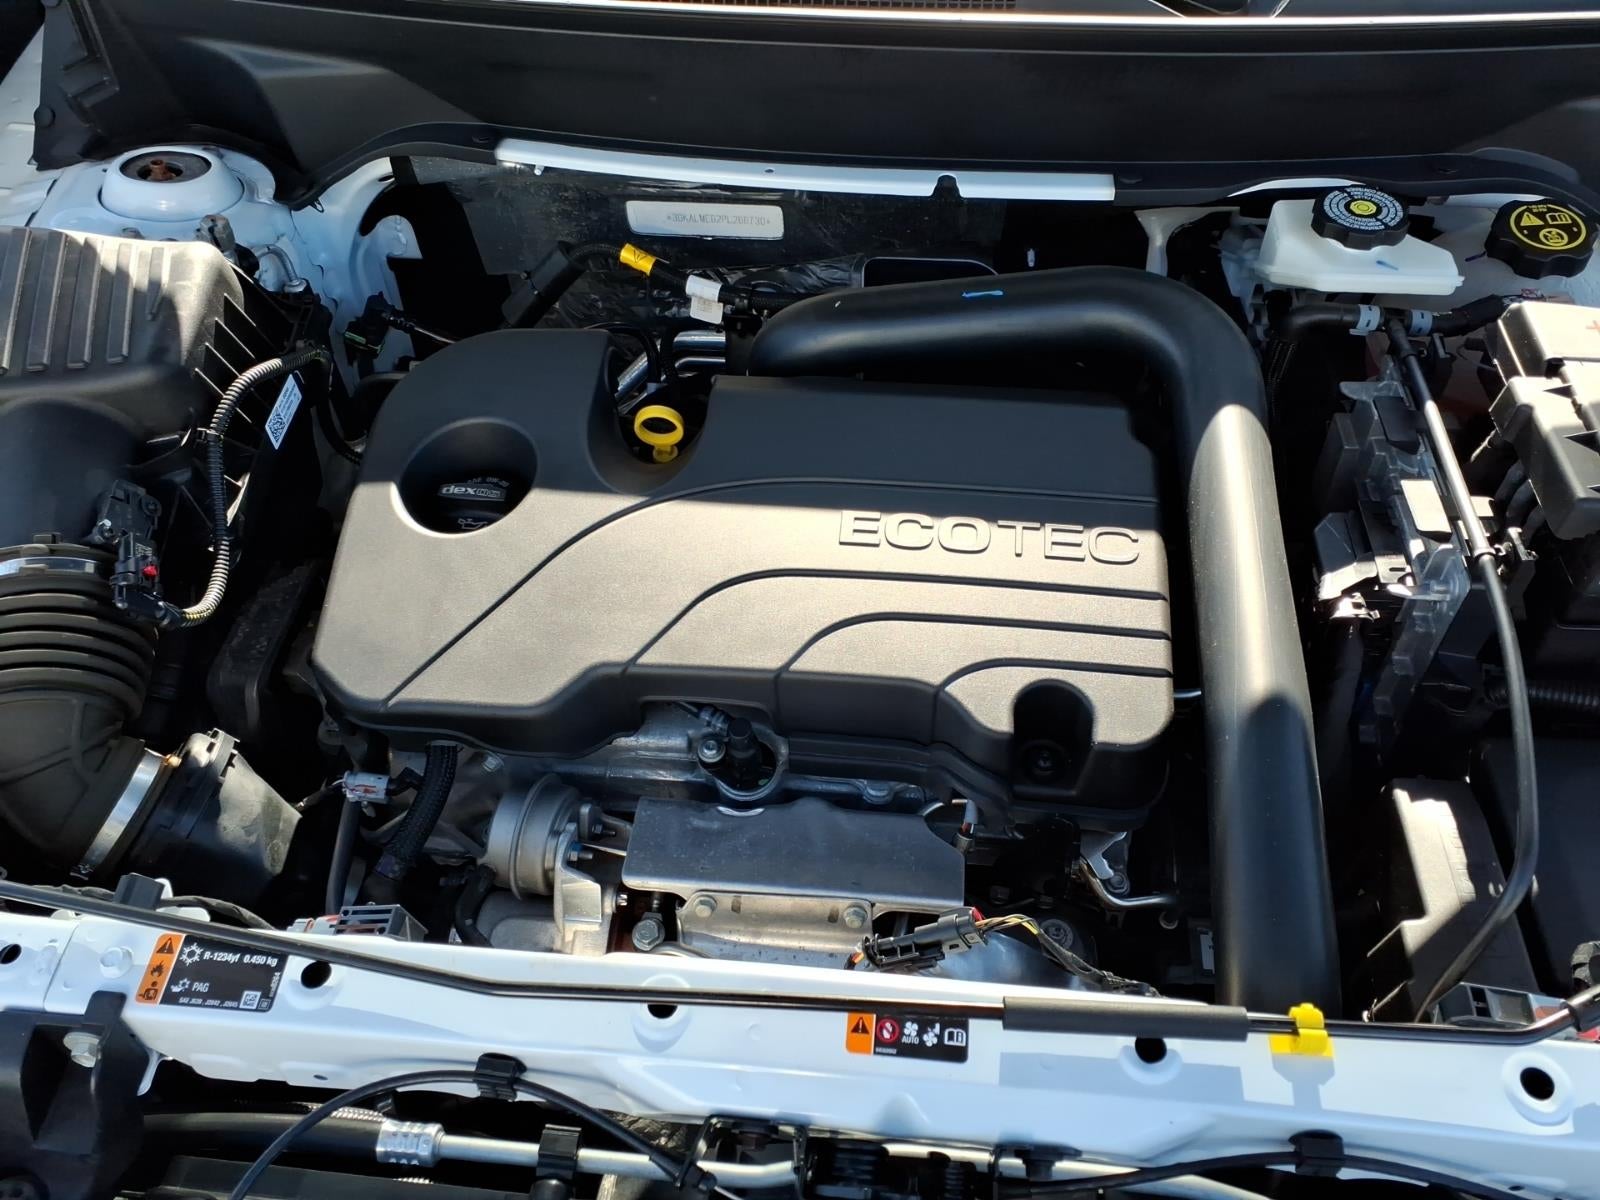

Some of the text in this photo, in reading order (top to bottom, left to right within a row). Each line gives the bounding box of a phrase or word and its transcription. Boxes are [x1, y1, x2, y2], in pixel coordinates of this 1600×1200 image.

[839, 510, 1140, 565] ECOTEC
[203, 951, 278, 967] R-1234yf 0.450 kg
[192, 982, 210, 992] PAG
[902, 1036, 919, 1045] AUTO
